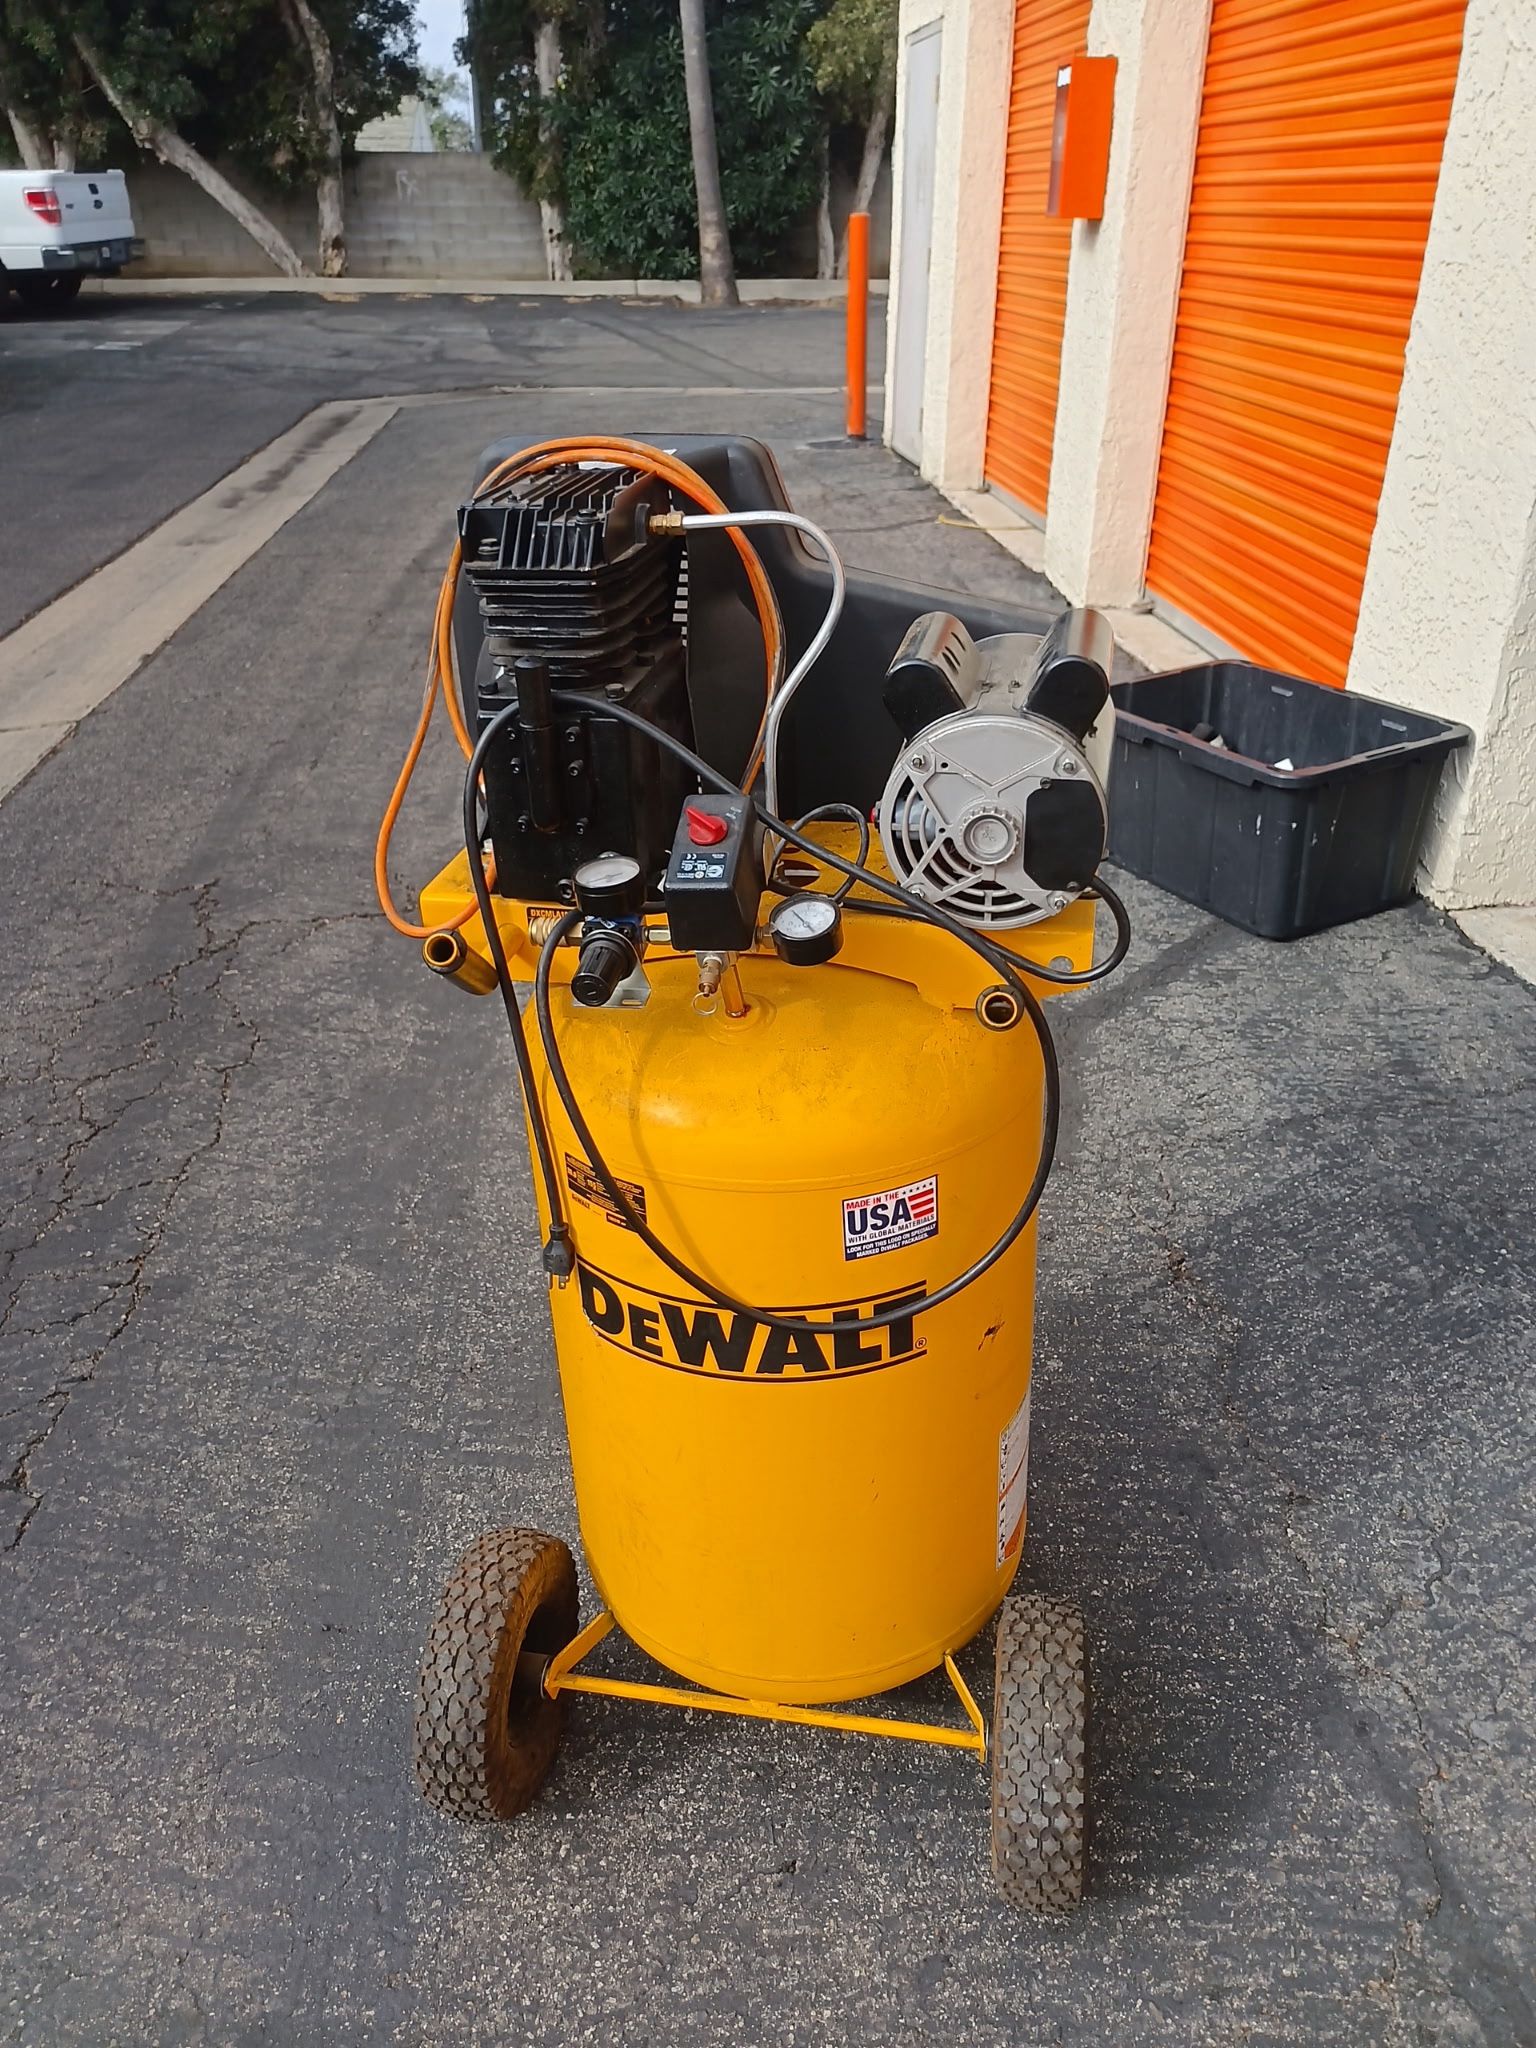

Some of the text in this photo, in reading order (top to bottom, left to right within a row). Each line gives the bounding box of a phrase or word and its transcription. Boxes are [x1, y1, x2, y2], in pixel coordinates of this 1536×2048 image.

[846, 1191, 900, 1210] MADE IN THE
[847, 1197, 912, 1236] USA
[848, 1214, 935, 1244] WITH GLOBAL MATERIALS
[846, 1245, 862, 1254] LOOK
[862, 1242, 874, 1250] FOR
[875, 1239, 887, 1247] THIS
